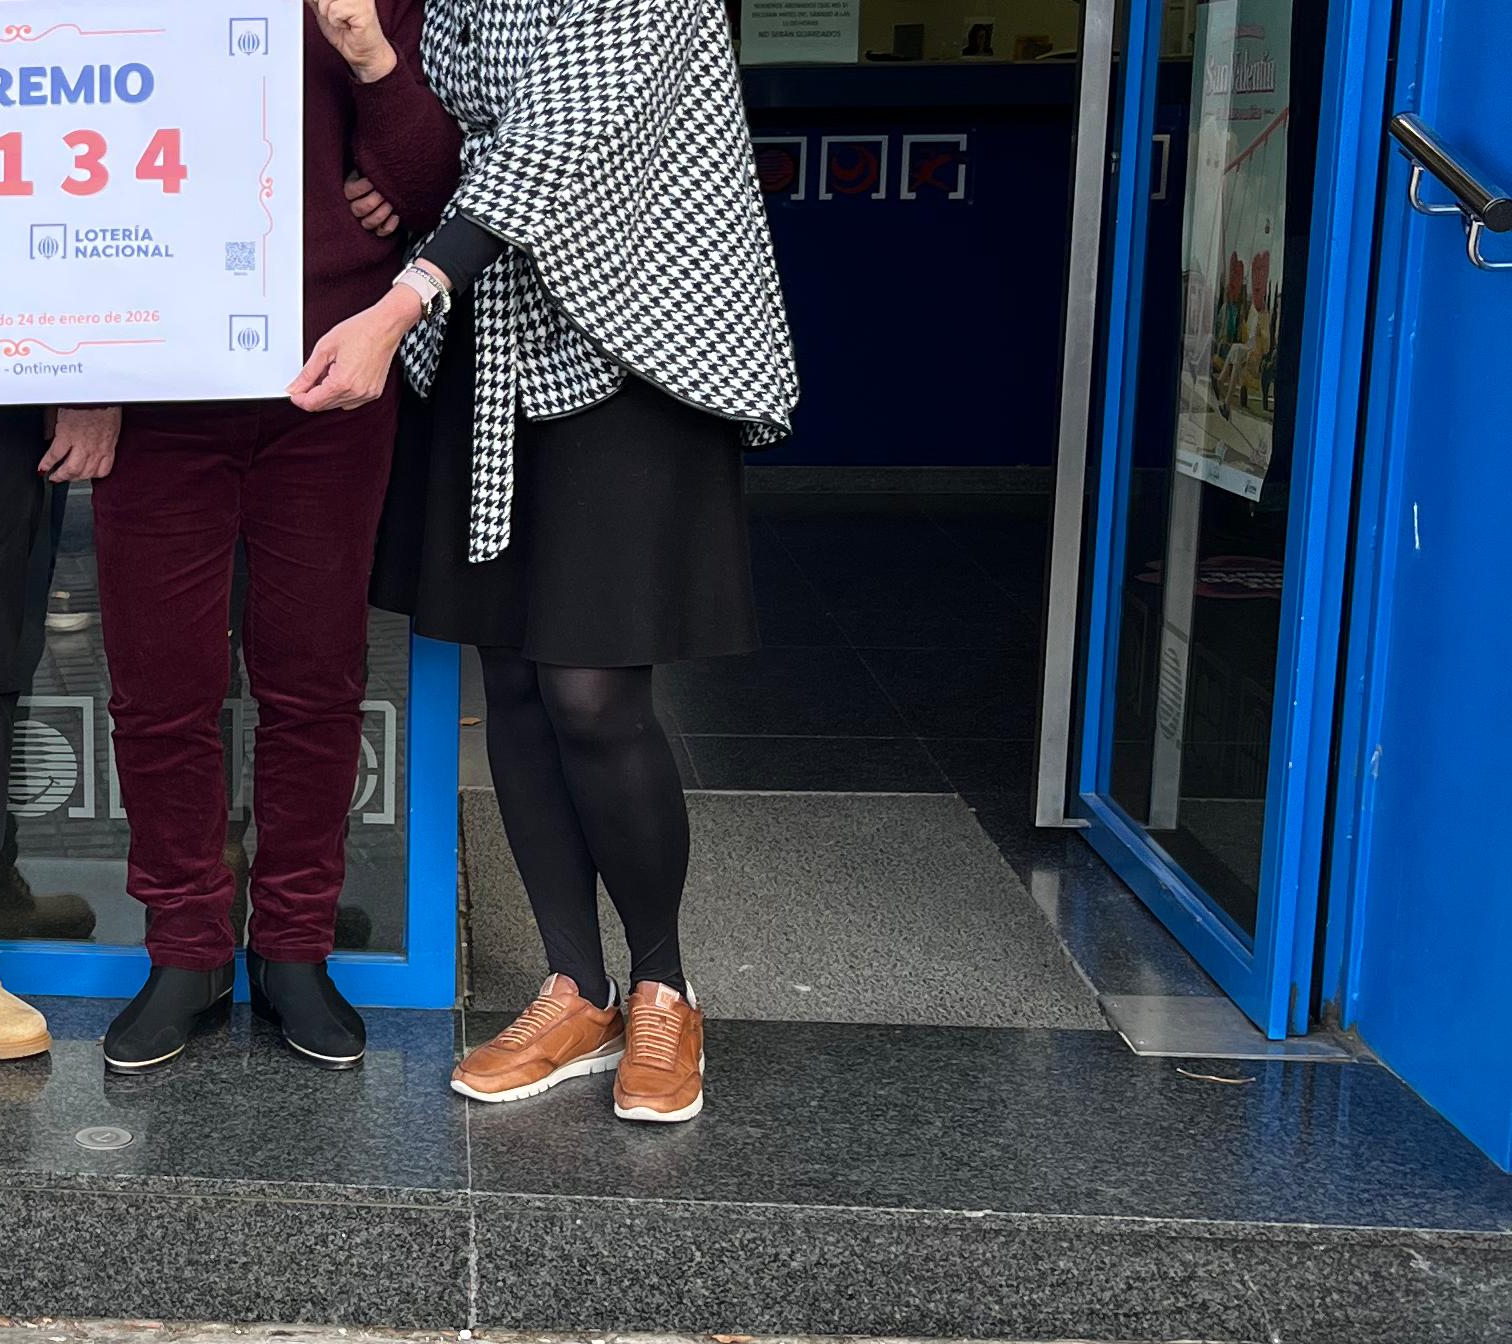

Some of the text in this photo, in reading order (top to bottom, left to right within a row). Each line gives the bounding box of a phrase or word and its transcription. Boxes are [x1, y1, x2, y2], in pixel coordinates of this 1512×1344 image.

[74, 225, 154, 243] LOTERÍA
[74, 244, 175, 259] NACIONAL
[18, 314, 34, 326] 24
[38, 312, 55, 326] de
[59, 314, 101, 326] enero
[104, 311, 122, 323] de
[125, 310, 160, 323] 2026
[12, 361, 84, 377] Ontinyent
